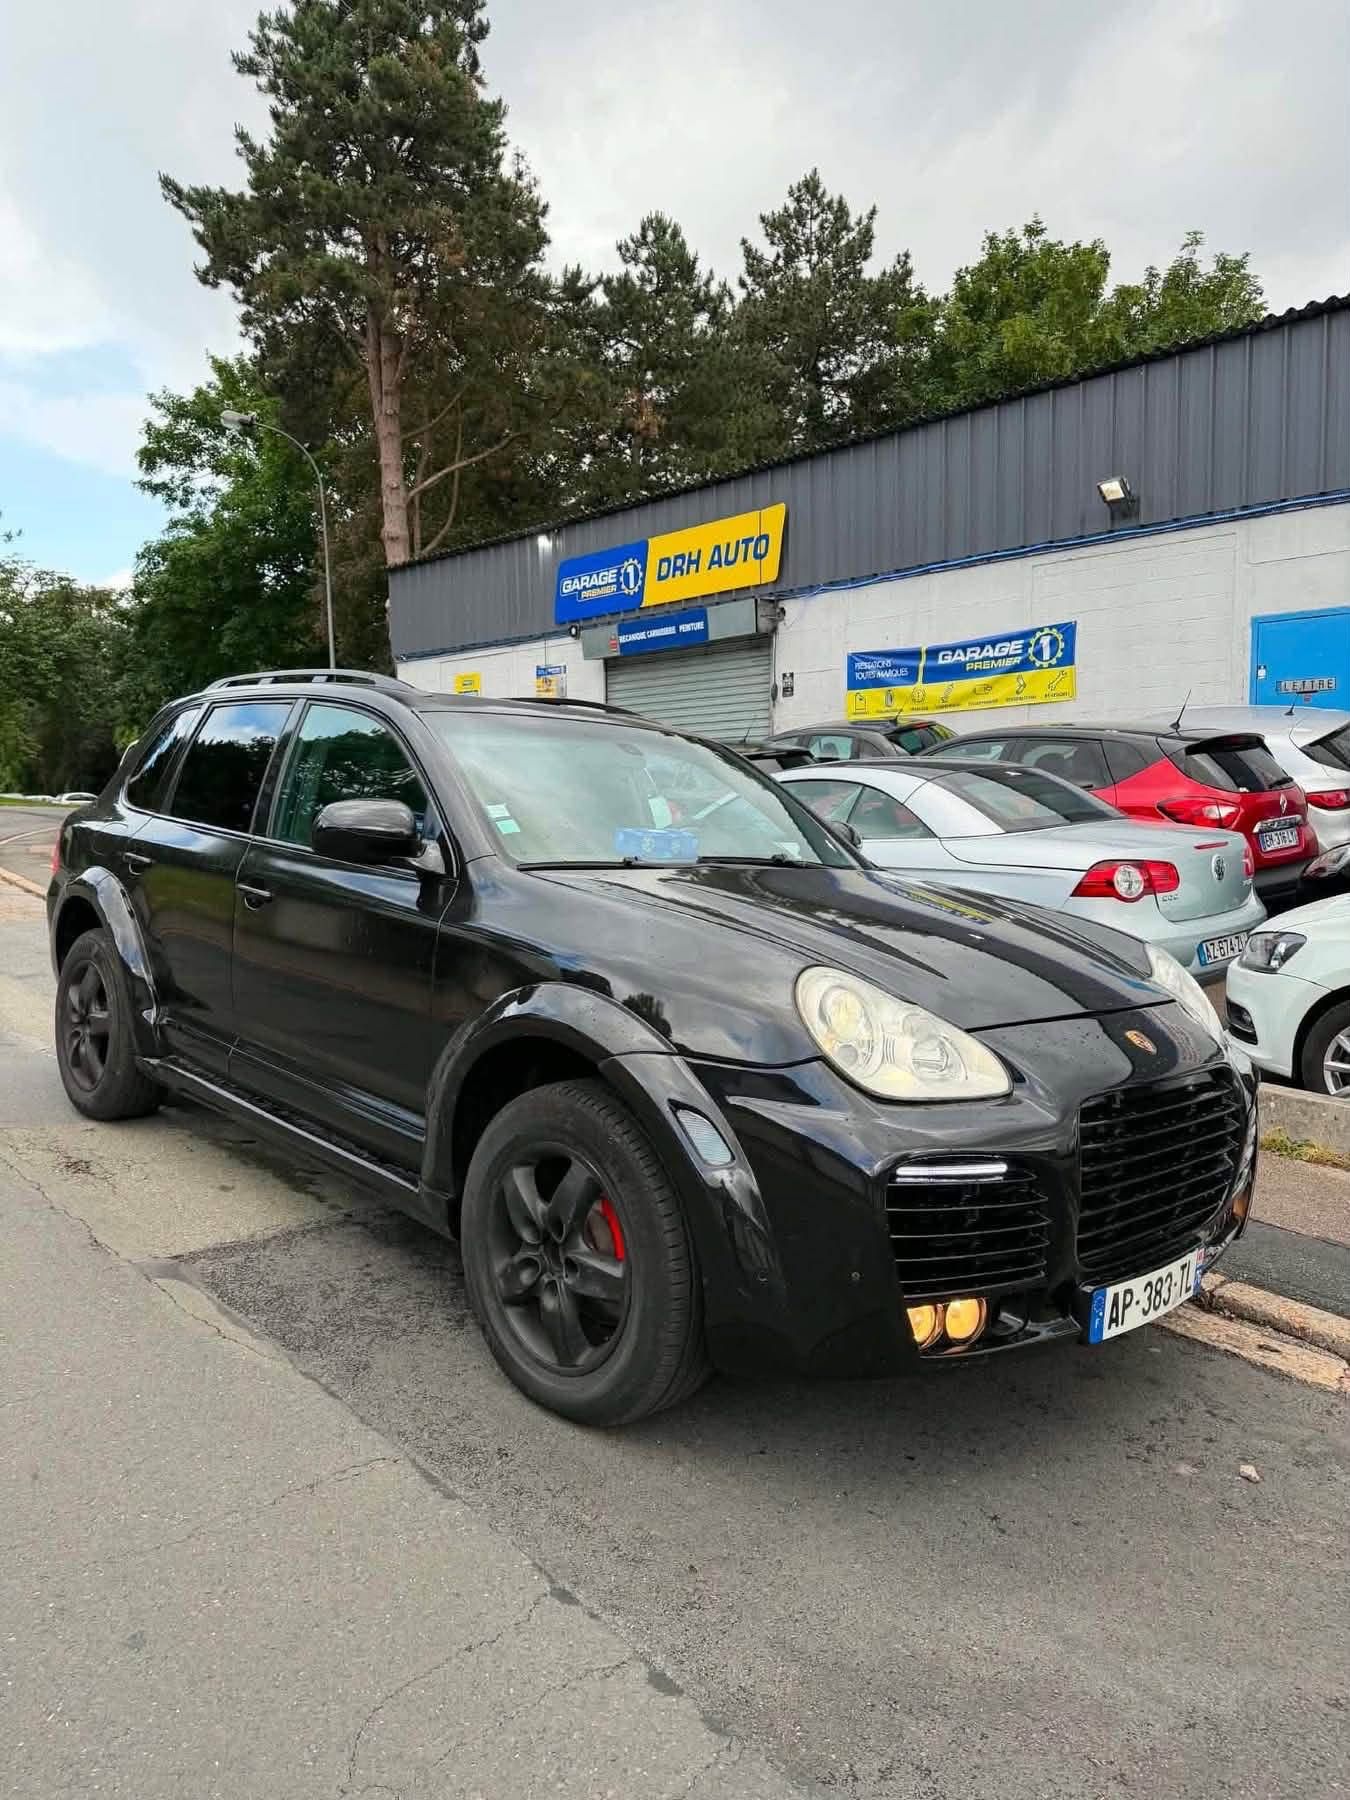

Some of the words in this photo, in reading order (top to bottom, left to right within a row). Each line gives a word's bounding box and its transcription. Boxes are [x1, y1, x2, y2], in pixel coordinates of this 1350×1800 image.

[657, 548, 702, 582] DRH
[707, 533, 770, 570] AUTO
[562, 569, 618, 593] GARAGE
[581, 584, 618, 600] PREMIER
[937, 639, 1025, 665] GARAGE
[965, 656, 1023, 672] PREMIER
[855, 670, 877, 681] TOUTES
[877, 667, 909, 680] MARQUES
[1107, 1260, 1193, 1330] AP-383-TL
